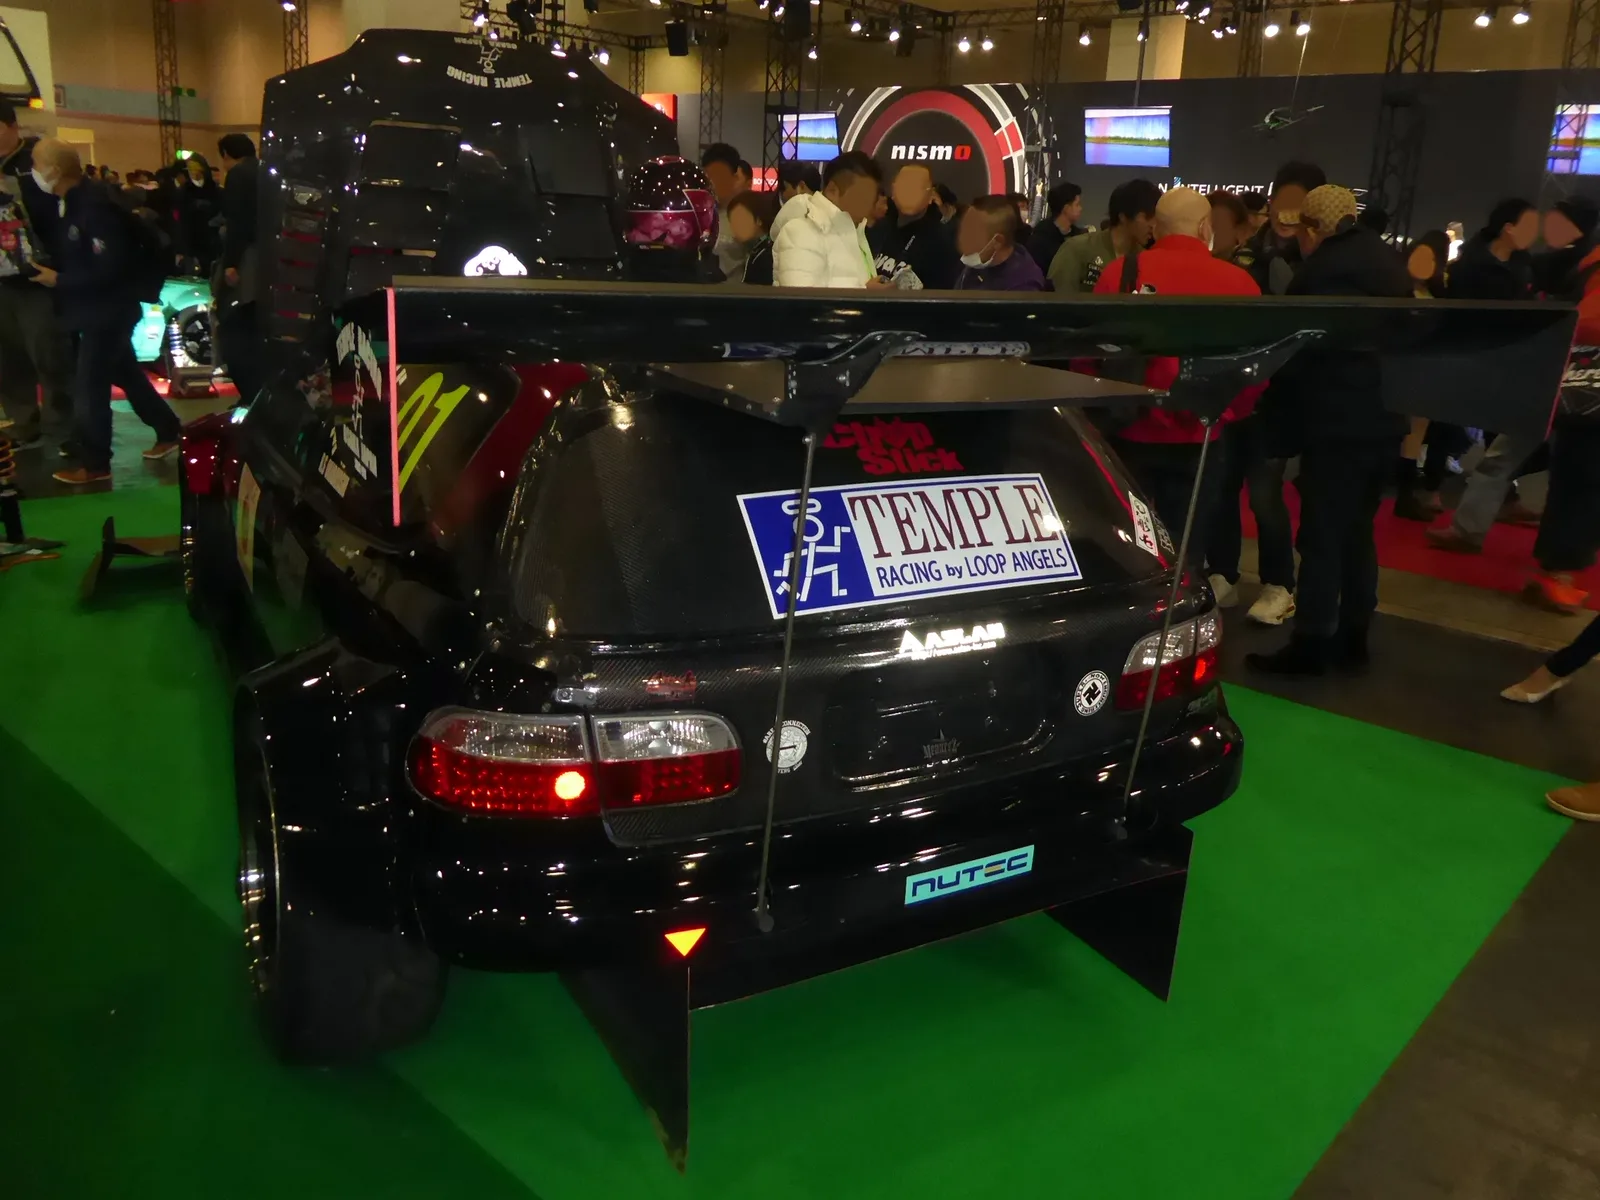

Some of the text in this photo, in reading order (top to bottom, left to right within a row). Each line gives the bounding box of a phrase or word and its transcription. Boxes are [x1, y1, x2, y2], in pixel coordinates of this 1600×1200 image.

[446, 65, 533, 89] TEMPLE RACING
[891, 145, 971, 160] nismo
[847, 484, 1059, 559] TEMPLE
[876, 547, 1068, 588] RACING by LOOP ANGELS
